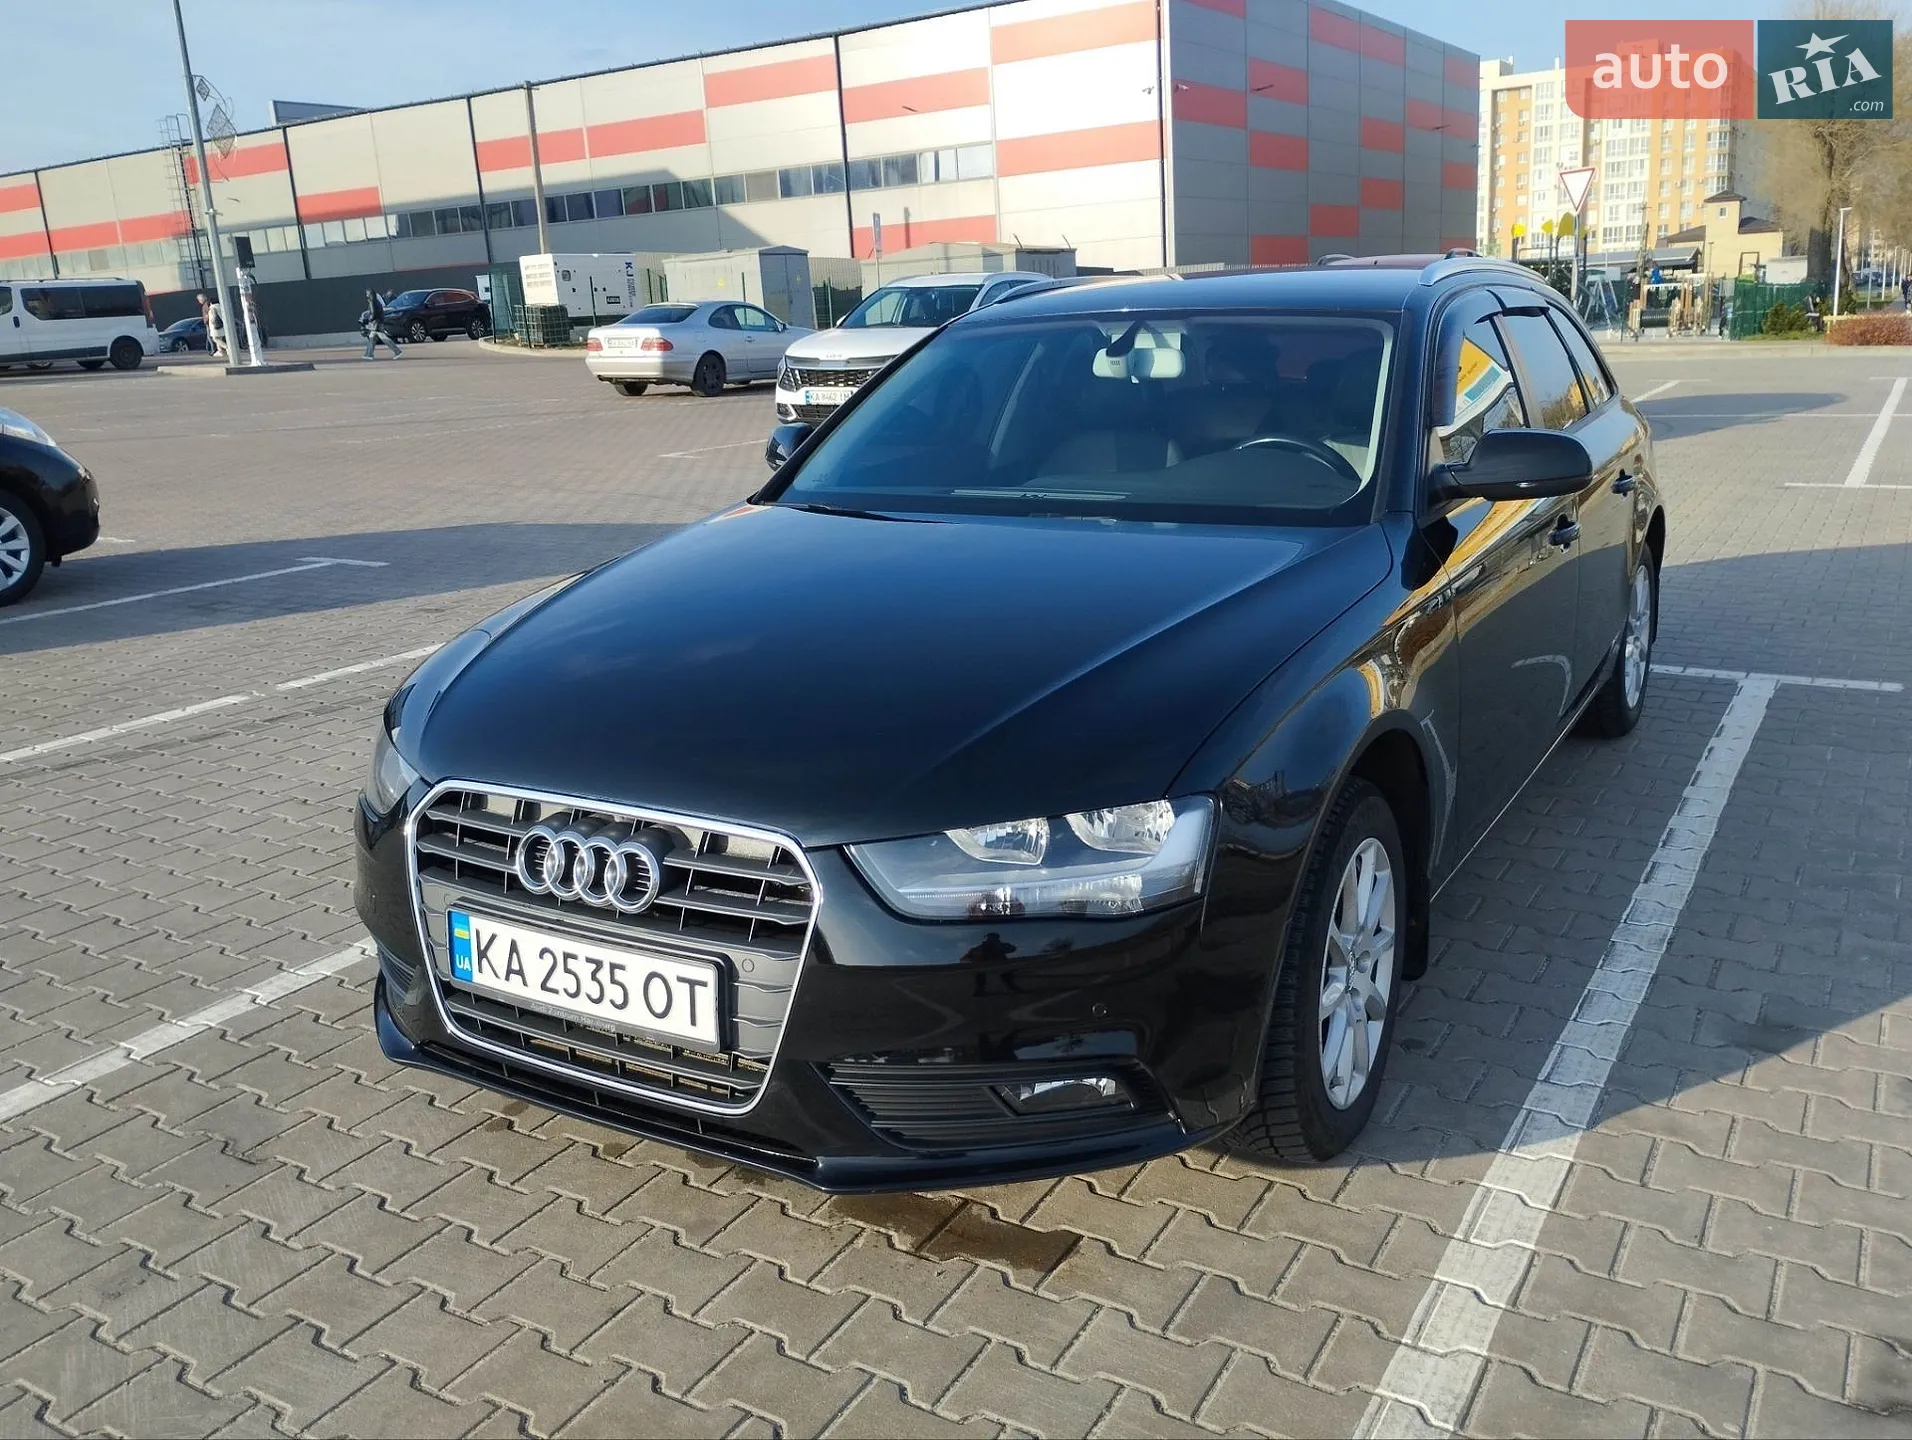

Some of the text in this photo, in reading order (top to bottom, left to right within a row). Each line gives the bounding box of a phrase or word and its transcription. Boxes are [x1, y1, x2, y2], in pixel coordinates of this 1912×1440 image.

[455, 954, 472, 972] UA
[475, 928, 709, 1027] KA 2535 OT
